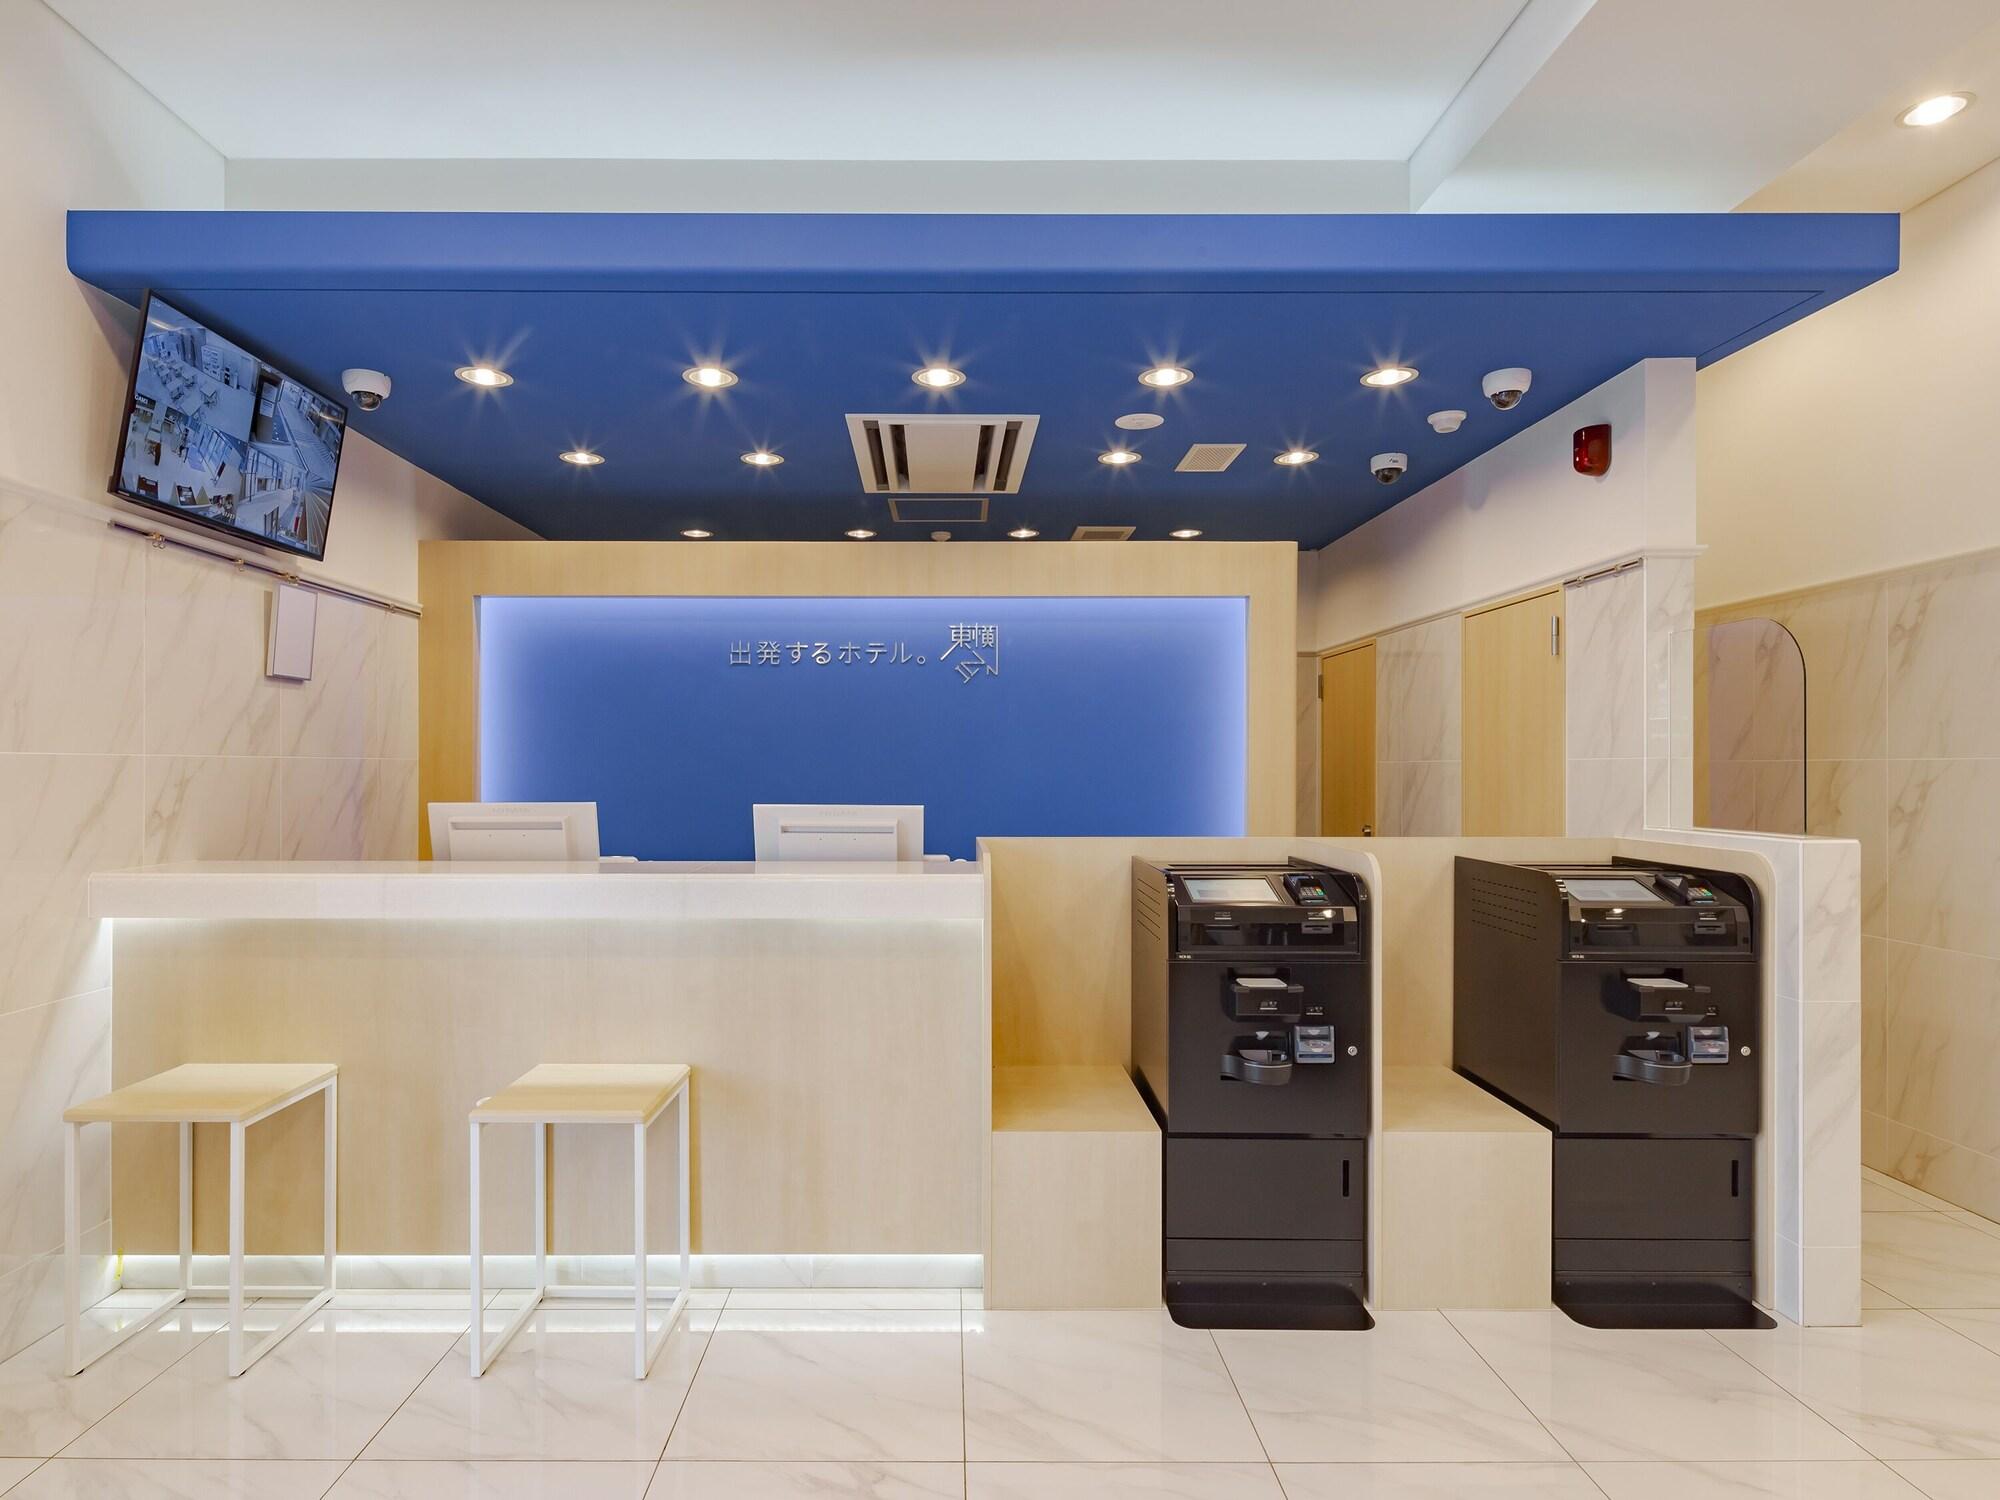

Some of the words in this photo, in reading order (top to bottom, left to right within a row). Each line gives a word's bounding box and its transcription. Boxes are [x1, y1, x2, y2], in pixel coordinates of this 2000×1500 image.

[729, 640, 927, 665] 出発するホテル。
